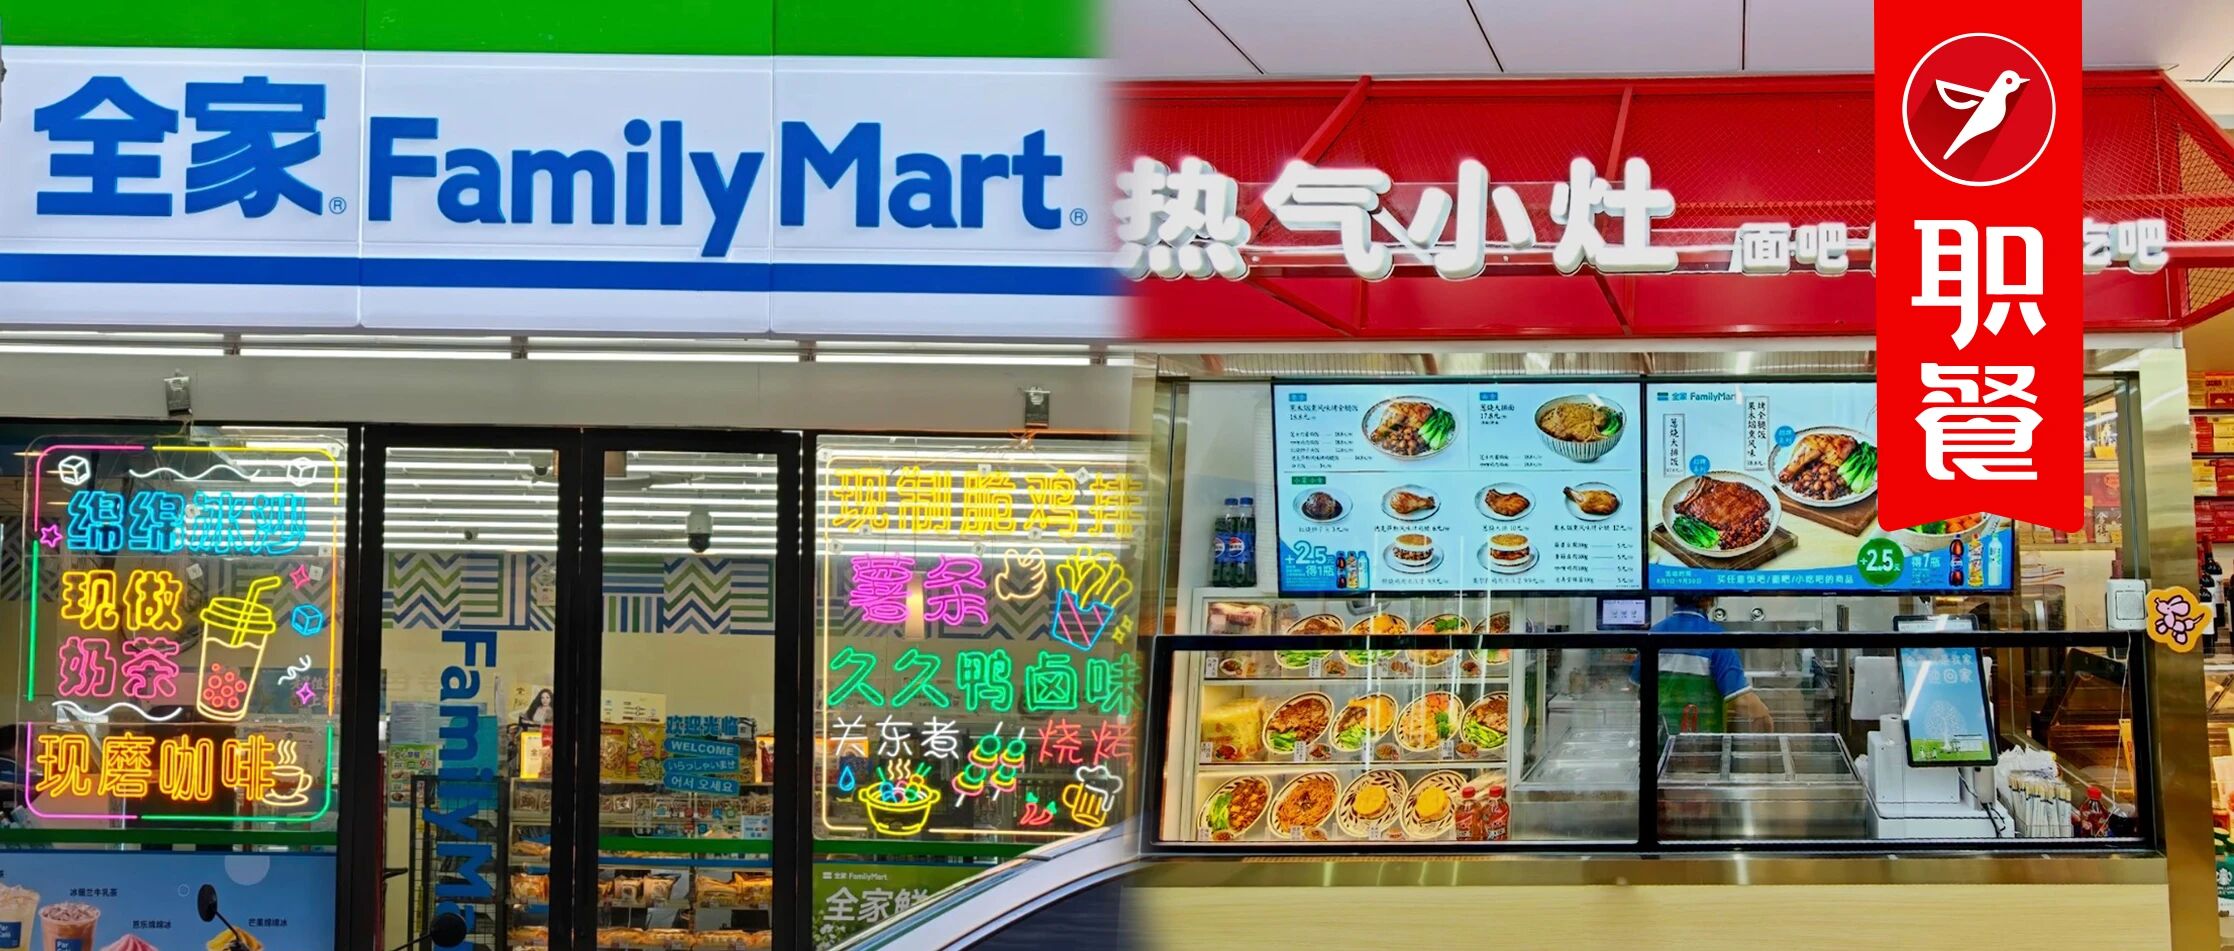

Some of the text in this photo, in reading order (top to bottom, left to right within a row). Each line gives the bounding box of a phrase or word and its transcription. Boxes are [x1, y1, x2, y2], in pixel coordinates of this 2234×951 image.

[34, 76, 1064, 258] 全家 FamilyMart
[1114, 156, 1678, 282] 热气小灶
[61, 570, 184, 632] 现做
[850, 552, 990, 626] 薯条
[58, 636, 182, 699] 奶茶
[827, 646, 1144, 716] 久久鸭卤味
[666, 715, 739, 737] 欢迎光临
[671, 740, 735, 756] WELCOME
[832, 714, 961, 760] 关东煮
[36, 732, 279, 803] 现磨咖啡
[671, 775, 734, 793] 어서 오세요
